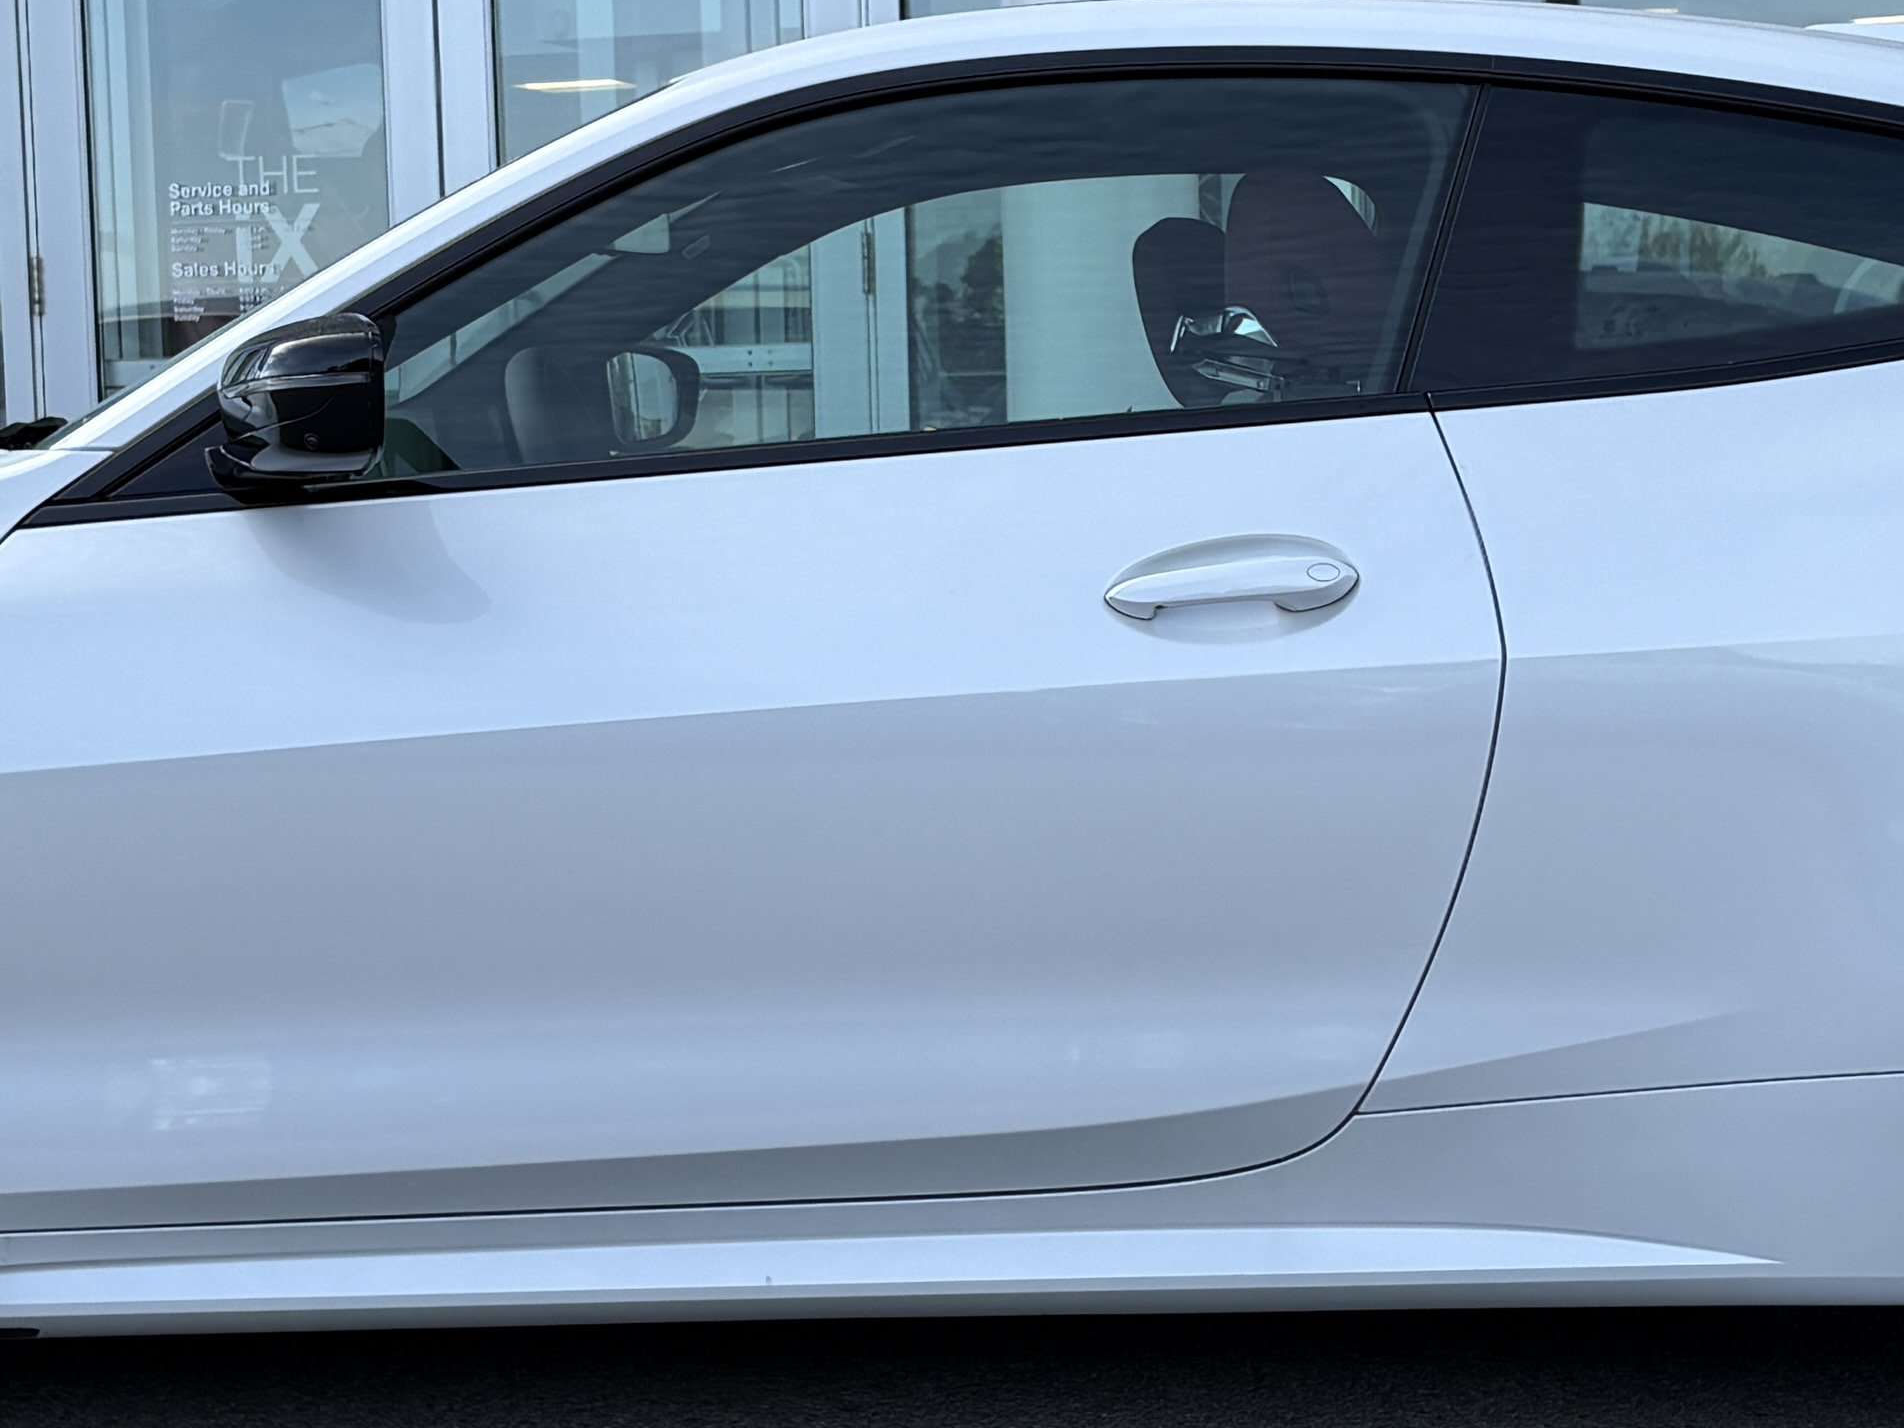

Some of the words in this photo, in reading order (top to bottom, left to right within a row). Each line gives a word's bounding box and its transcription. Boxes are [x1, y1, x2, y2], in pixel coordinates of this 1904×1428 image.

[225, 155, 320, 194] THE
[168, 183, 233, 200] Service
[238, 180, 270, 197] and
[170, 201, 214, 217] Parts
[218, 199, 271, 215] Hours
[171, 262, 219, 278] Sales
